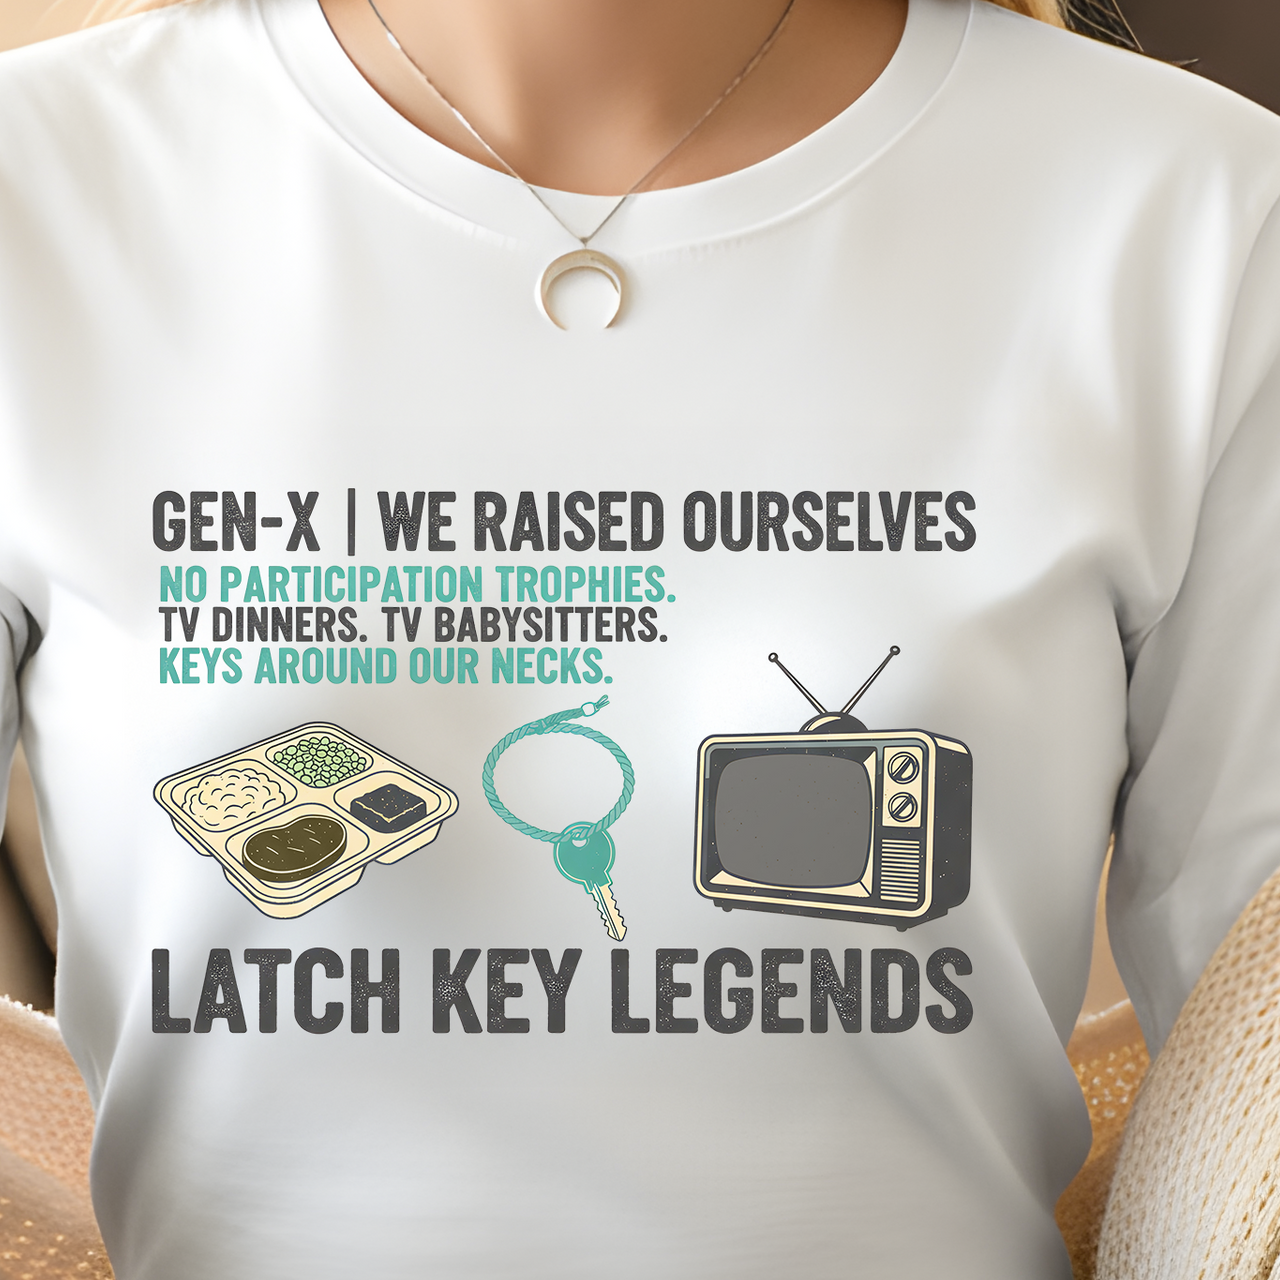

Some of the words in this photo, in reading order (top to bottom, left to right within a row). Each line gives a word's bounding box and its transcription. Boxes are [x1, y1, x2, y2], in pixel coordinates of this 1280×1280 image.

[153, 491, 320, 551] GEN-X
[377, 491, 456, 551] WE
[475, 491, 664, 551] RAISED
[684, 491, 976, 552] OURSELVES
[161, 566, 206, 602] NO
[221, 566, 482, 602] PARTICIPATION
[495, 566, 676, 602] TROPHIES.
[159, 607, 199, 642] TV
[213, 607, 367, 642] DINNERS.
[381, 607, 422, 642] TV
[435, 606, 667, 642] BABYSITTERS.
[160, 648, 242, 684] KEYS
[254, 647, 396, 684] AROUND
[410, 647, 478, 684] OUR
[492, 647, 612, 684] NECKS.
[152, 947, 400, 1034] LATCH
[433, 948, 582, 1033] KEY
[611, 947, 974, 1034] LEGENDS
